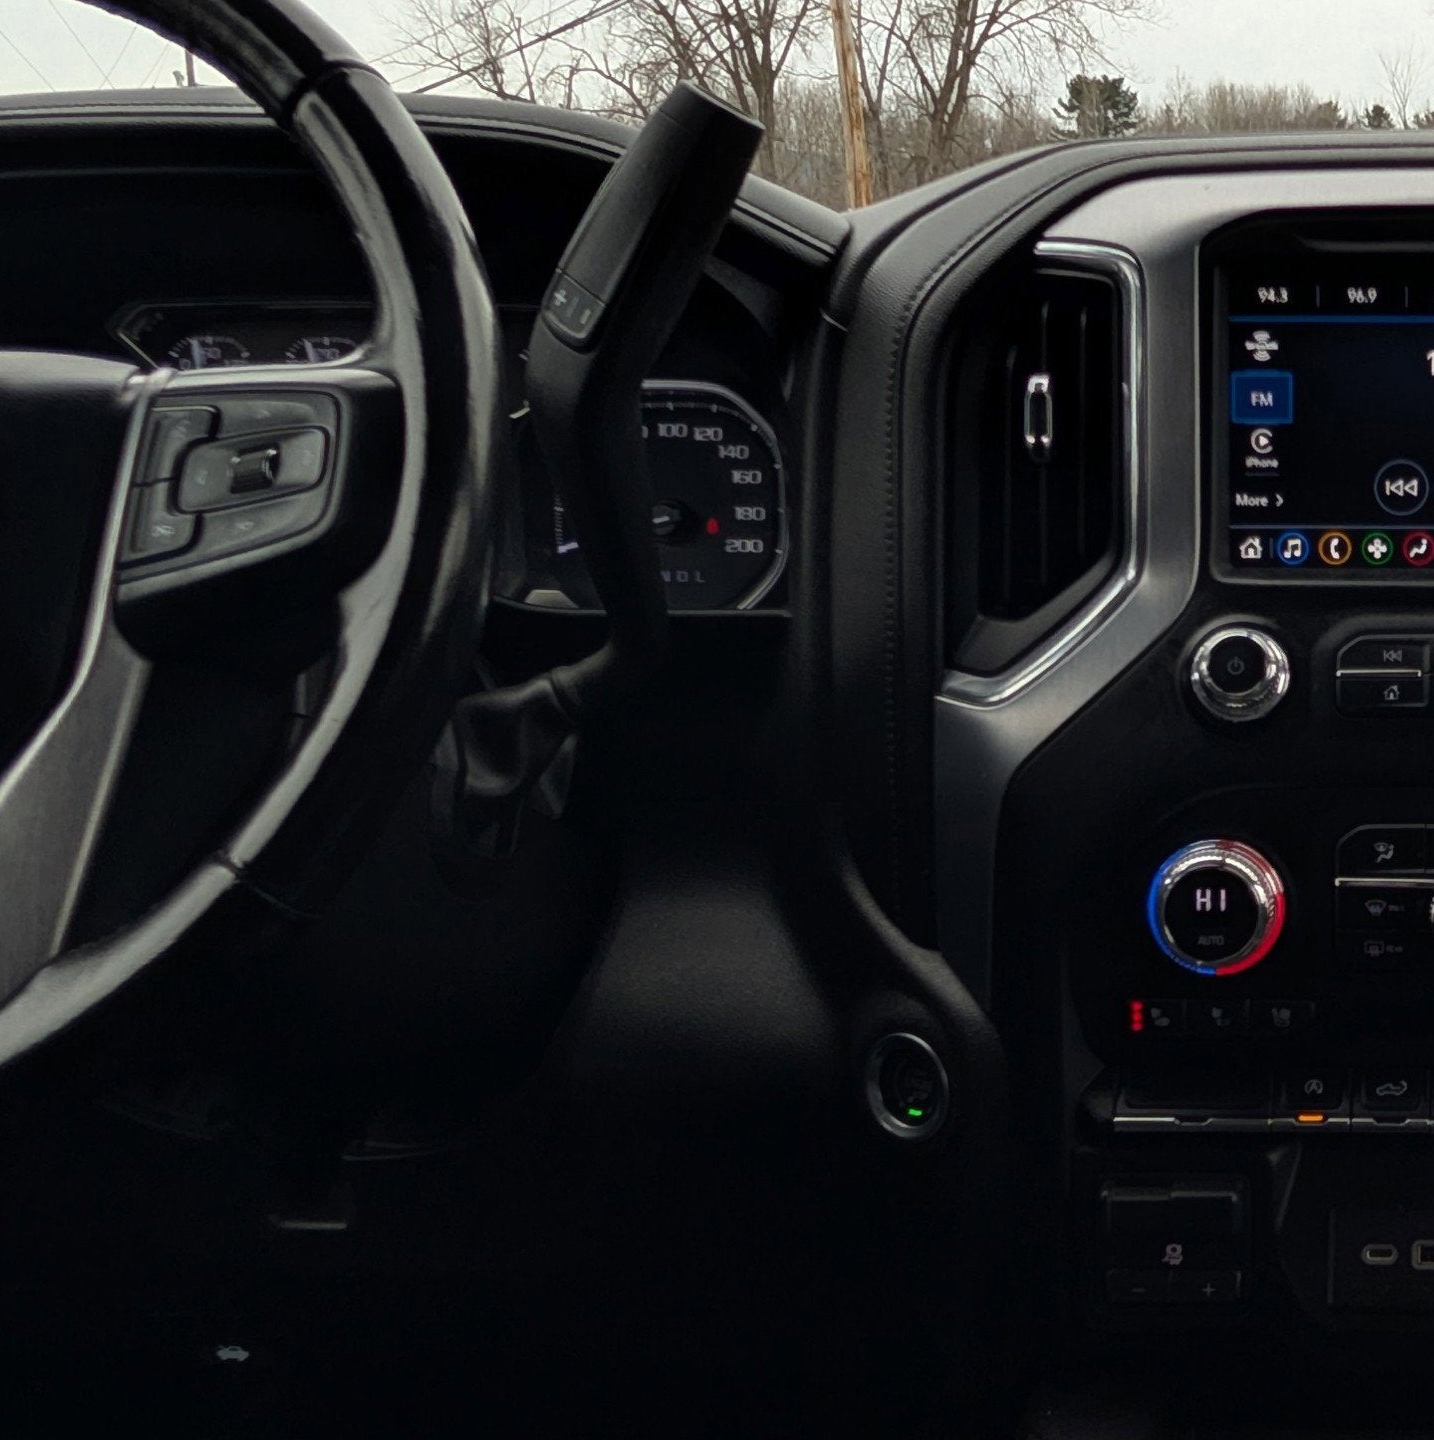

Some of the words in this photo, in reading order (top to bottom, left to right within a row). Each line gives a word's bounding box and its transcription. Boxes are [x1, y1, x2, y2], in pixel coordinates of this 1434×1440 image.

[1257, 286, 1289, 304] 94.3
[1346, 286, 1378, 304] 96.9
[1250, 391, 1273, 407] FM
[657, 422, 688, 438] 100
[693, 426, 723, 442] 120
[718, 444, 750, 460] 140
[731, 469, 762, 485] 160
[1235, 492, 1269, 507] More
[734, 506, 766, 521] 180
[724, 538, 764, 553] 200
[1195, 888, 1227, 912] HI
[1198, 935, 1225, 947] AUTO
